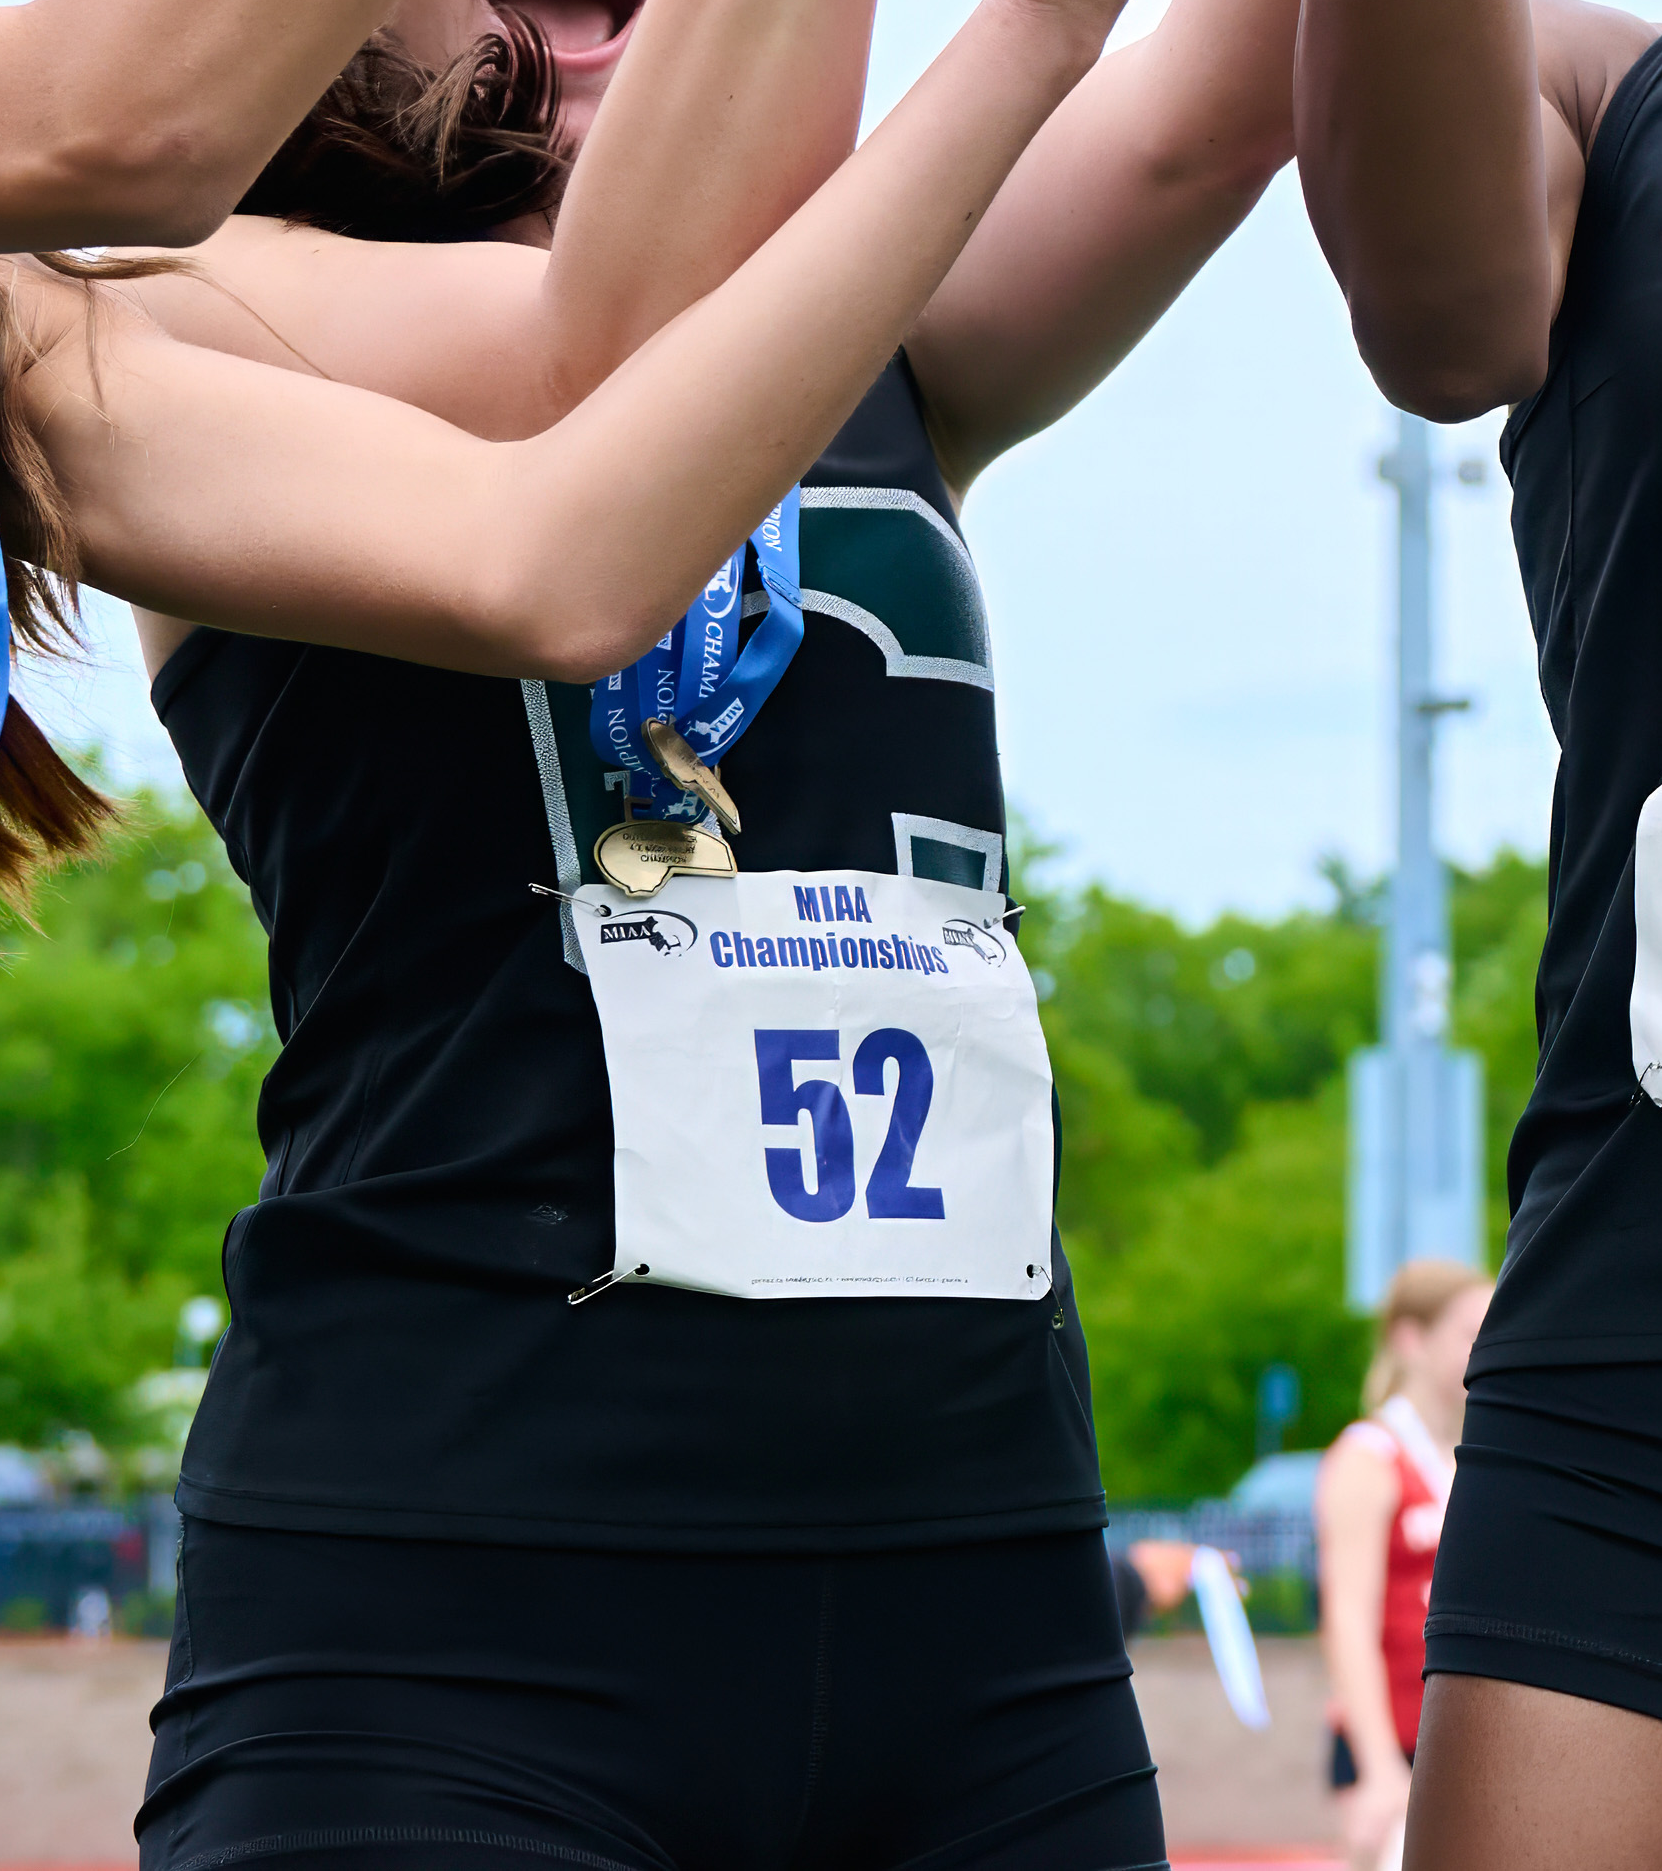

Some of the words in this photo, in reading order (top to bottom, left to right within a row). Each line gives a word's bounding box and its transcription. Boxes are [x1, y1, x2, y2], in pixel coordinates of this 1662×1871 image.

[698, 621, 724, 699] CHAM
[793, 885, 872, 923] MIAA
[603, 924, 651, 941] MIAA
[709, 931, 949, 975] Championships
[754, 1027, 946, 1224] 52
